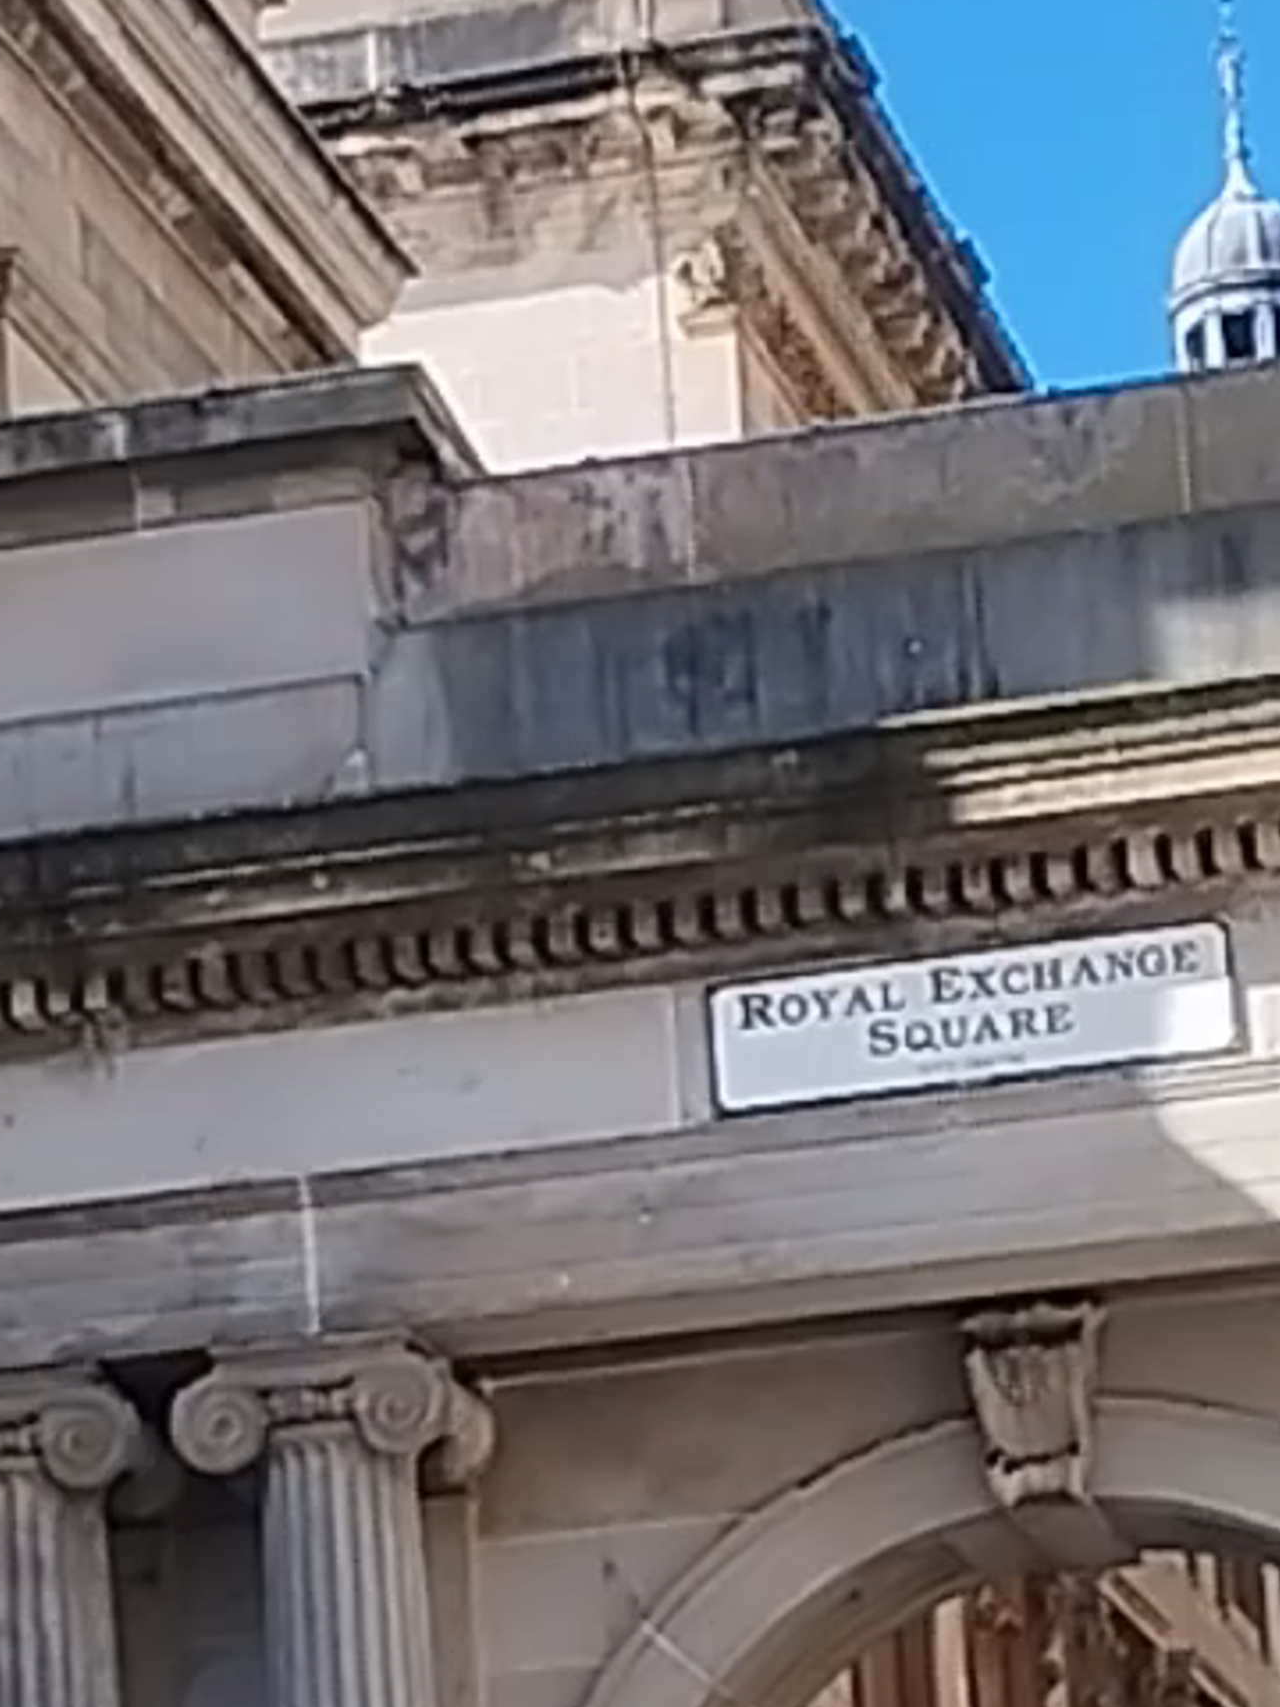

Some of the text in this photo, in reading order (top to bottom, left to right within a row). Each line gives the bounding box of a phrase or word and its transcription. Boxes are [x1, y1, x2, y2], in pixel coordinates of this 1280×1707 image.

[738, 939, 1201, 1031] ROYAL EXCHANGE
[868, 1003, 1076, 1058] SQUARE
